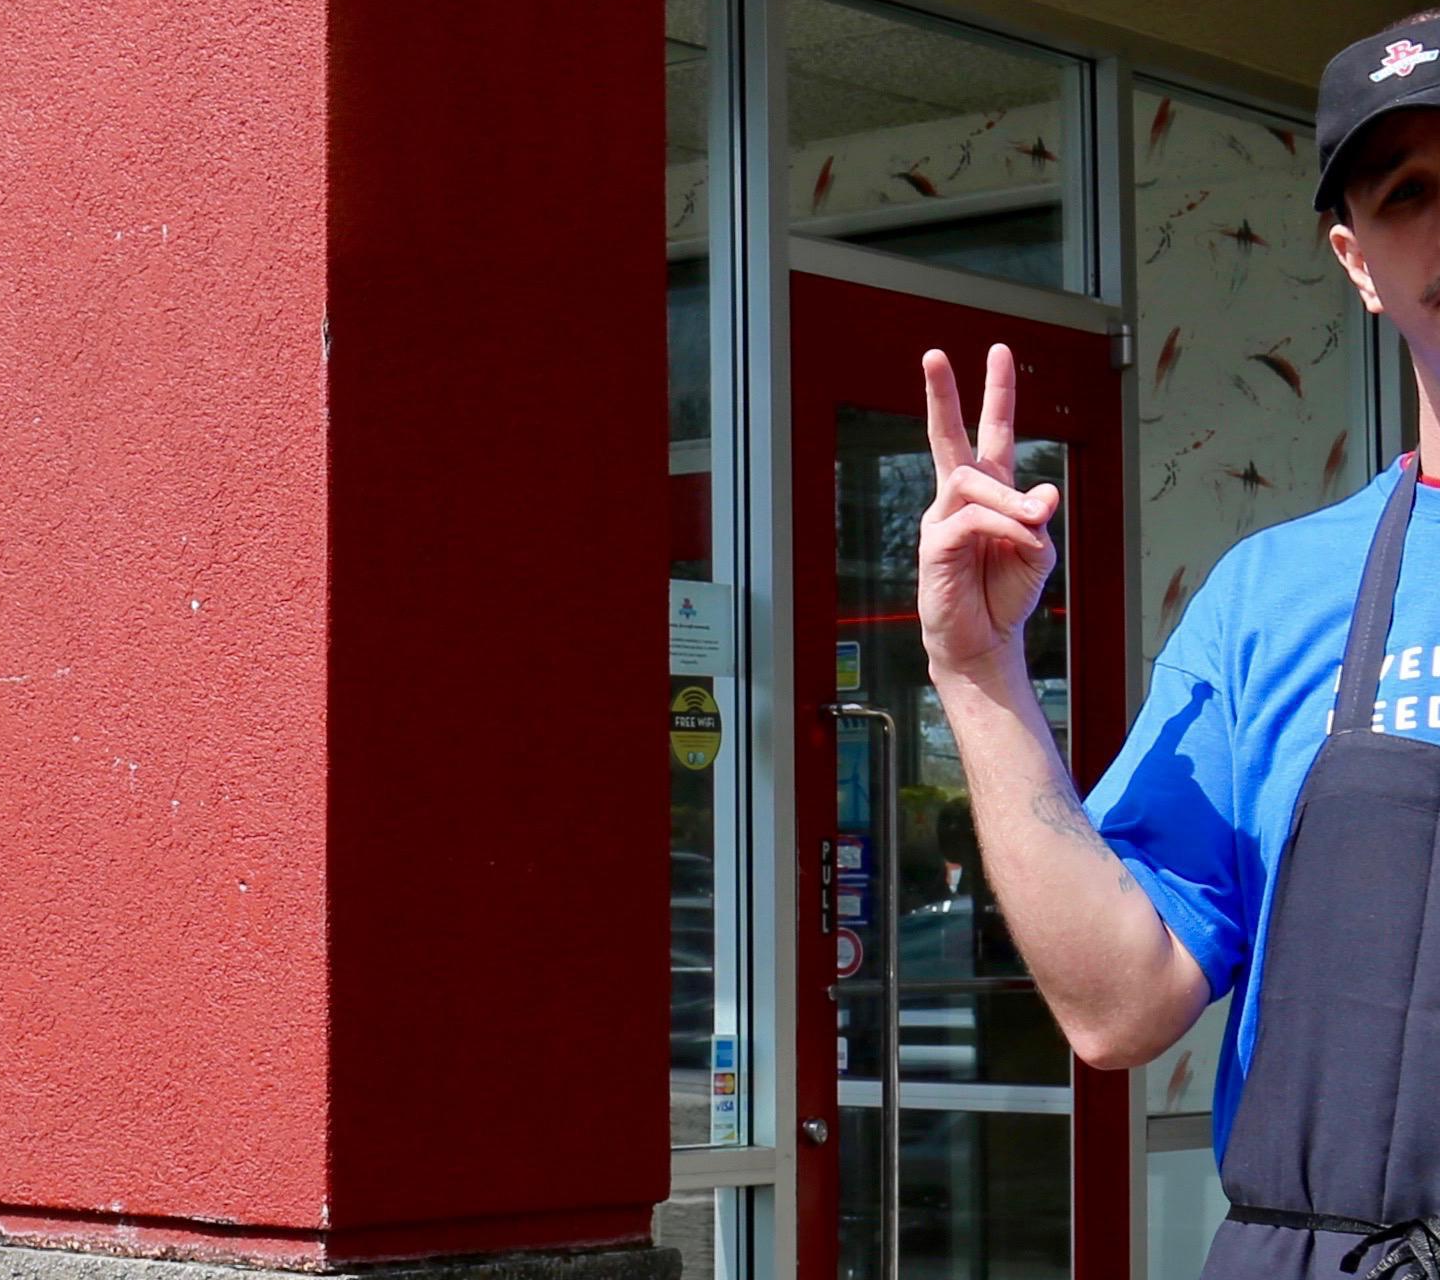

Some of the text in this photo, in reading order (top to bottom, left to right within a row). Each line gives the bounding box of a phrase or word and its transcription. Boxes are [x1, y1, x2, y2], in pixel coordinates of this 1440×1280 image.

[674, 716, 696, 728] FREE
[822, 840, 831, 934] PULL
[716, 1100, 734, 1112] VISA
